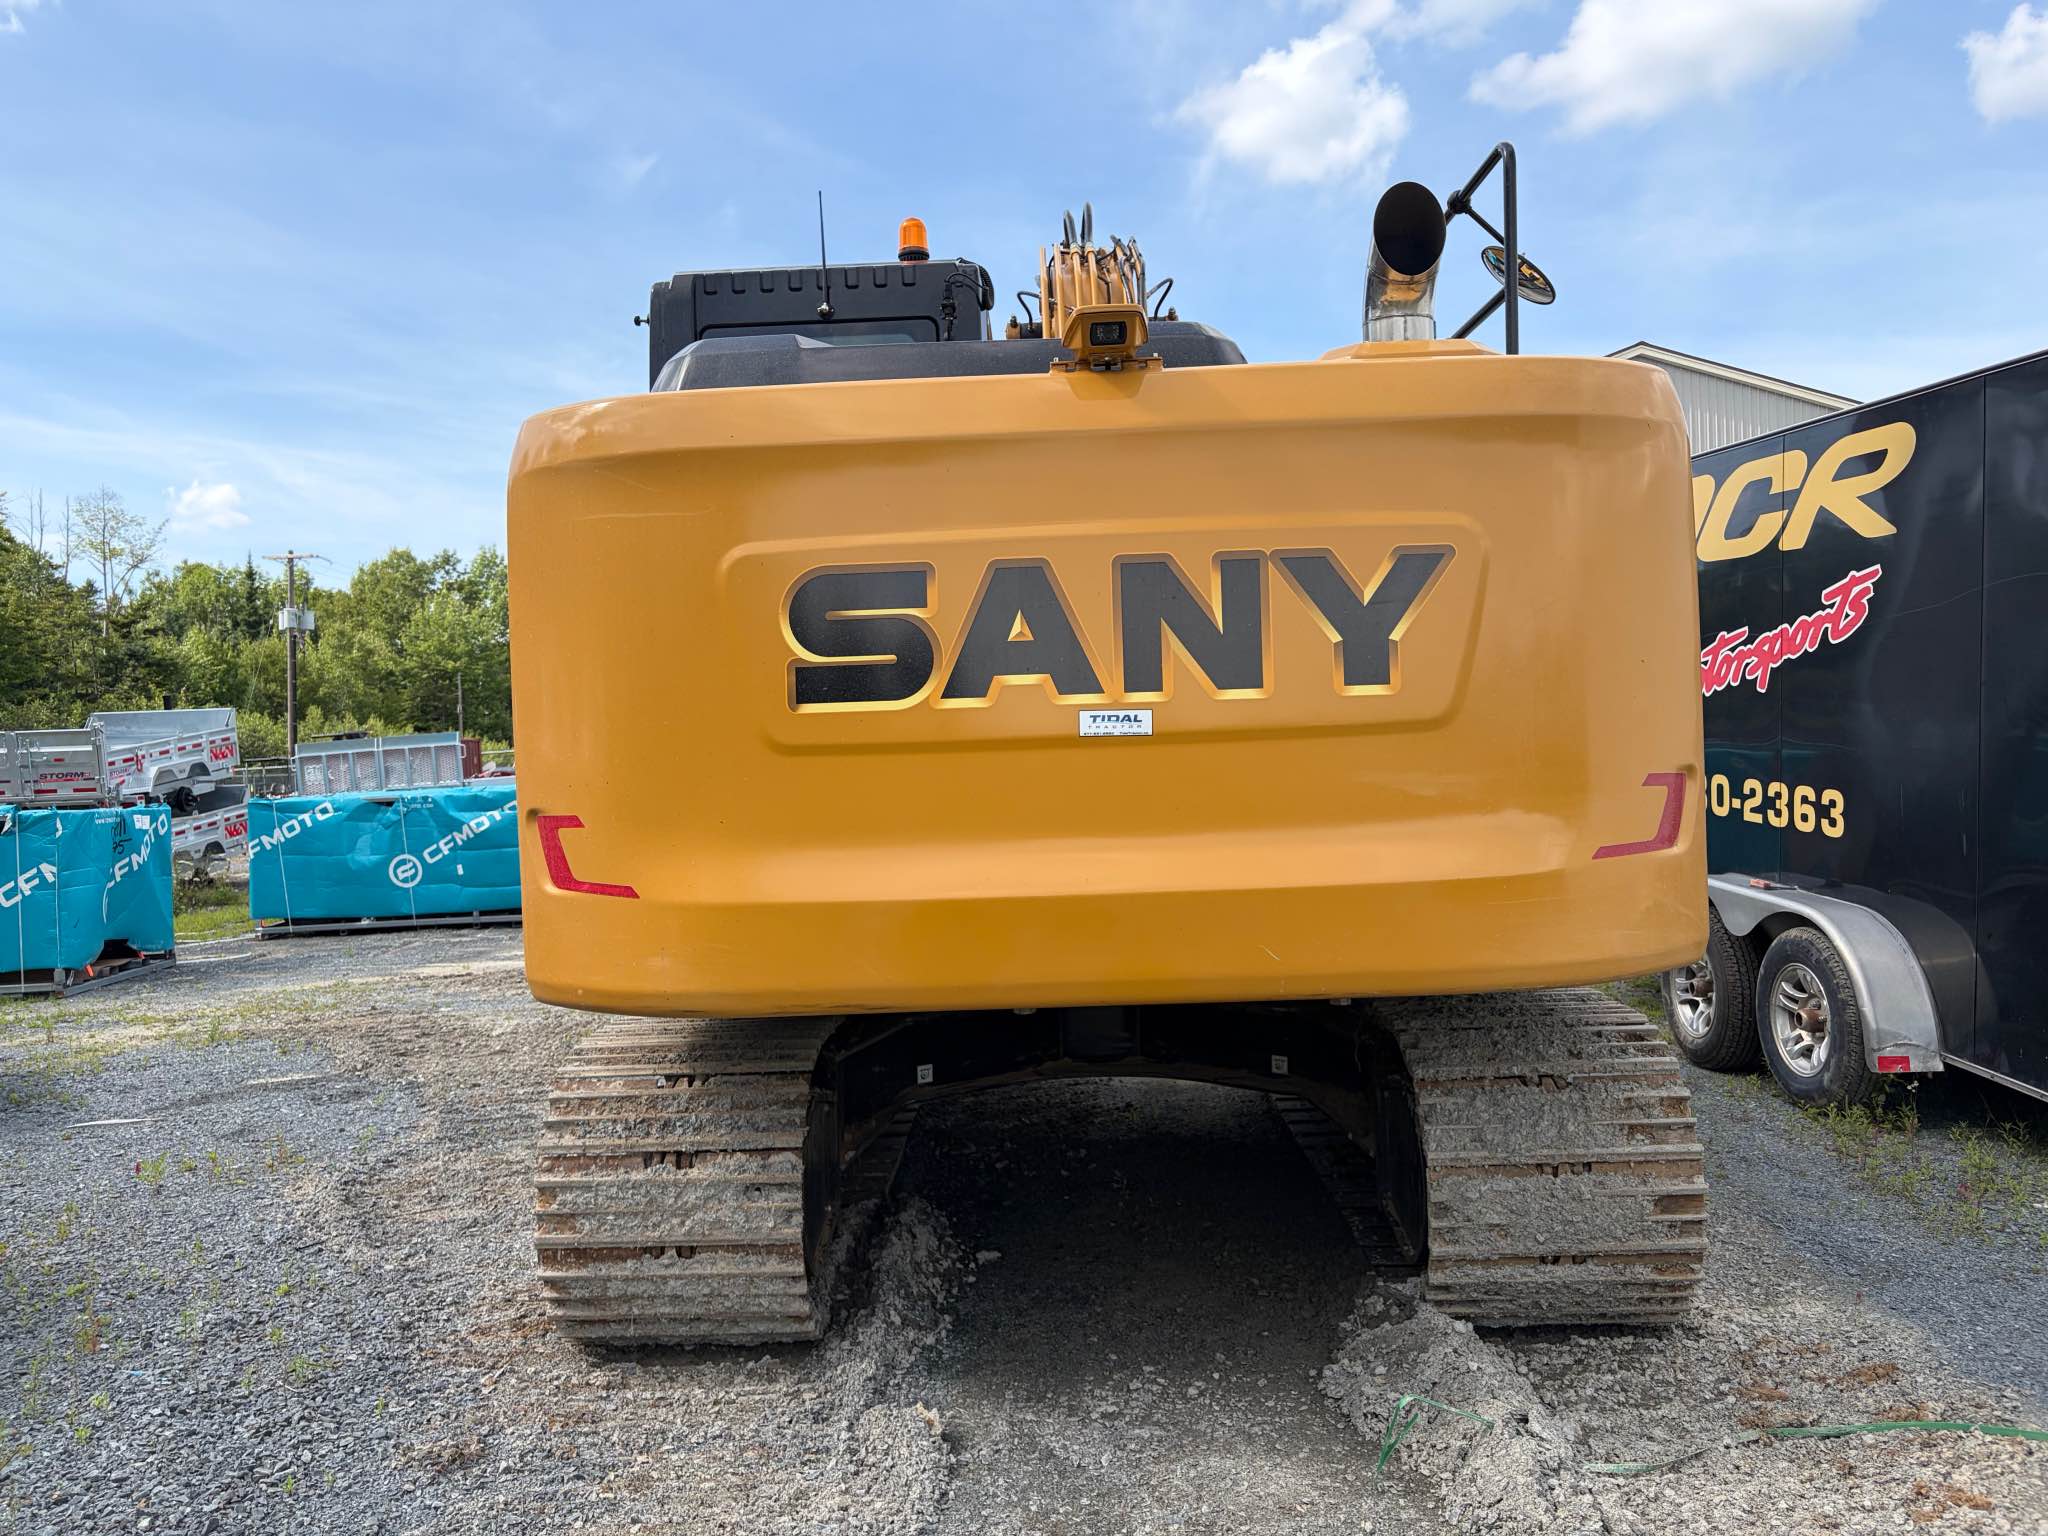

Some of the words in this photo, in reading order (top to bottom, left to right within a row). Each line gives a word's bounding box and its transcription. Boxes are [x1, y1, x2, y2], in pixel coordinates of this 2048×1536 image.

[782, 546, 1456, 711] SANY
[1089, 714, 1143, 723] TIDAL
[1705, 773, 1845, 839] 0-2363
[107, 813, 169, 889] FMOTO
